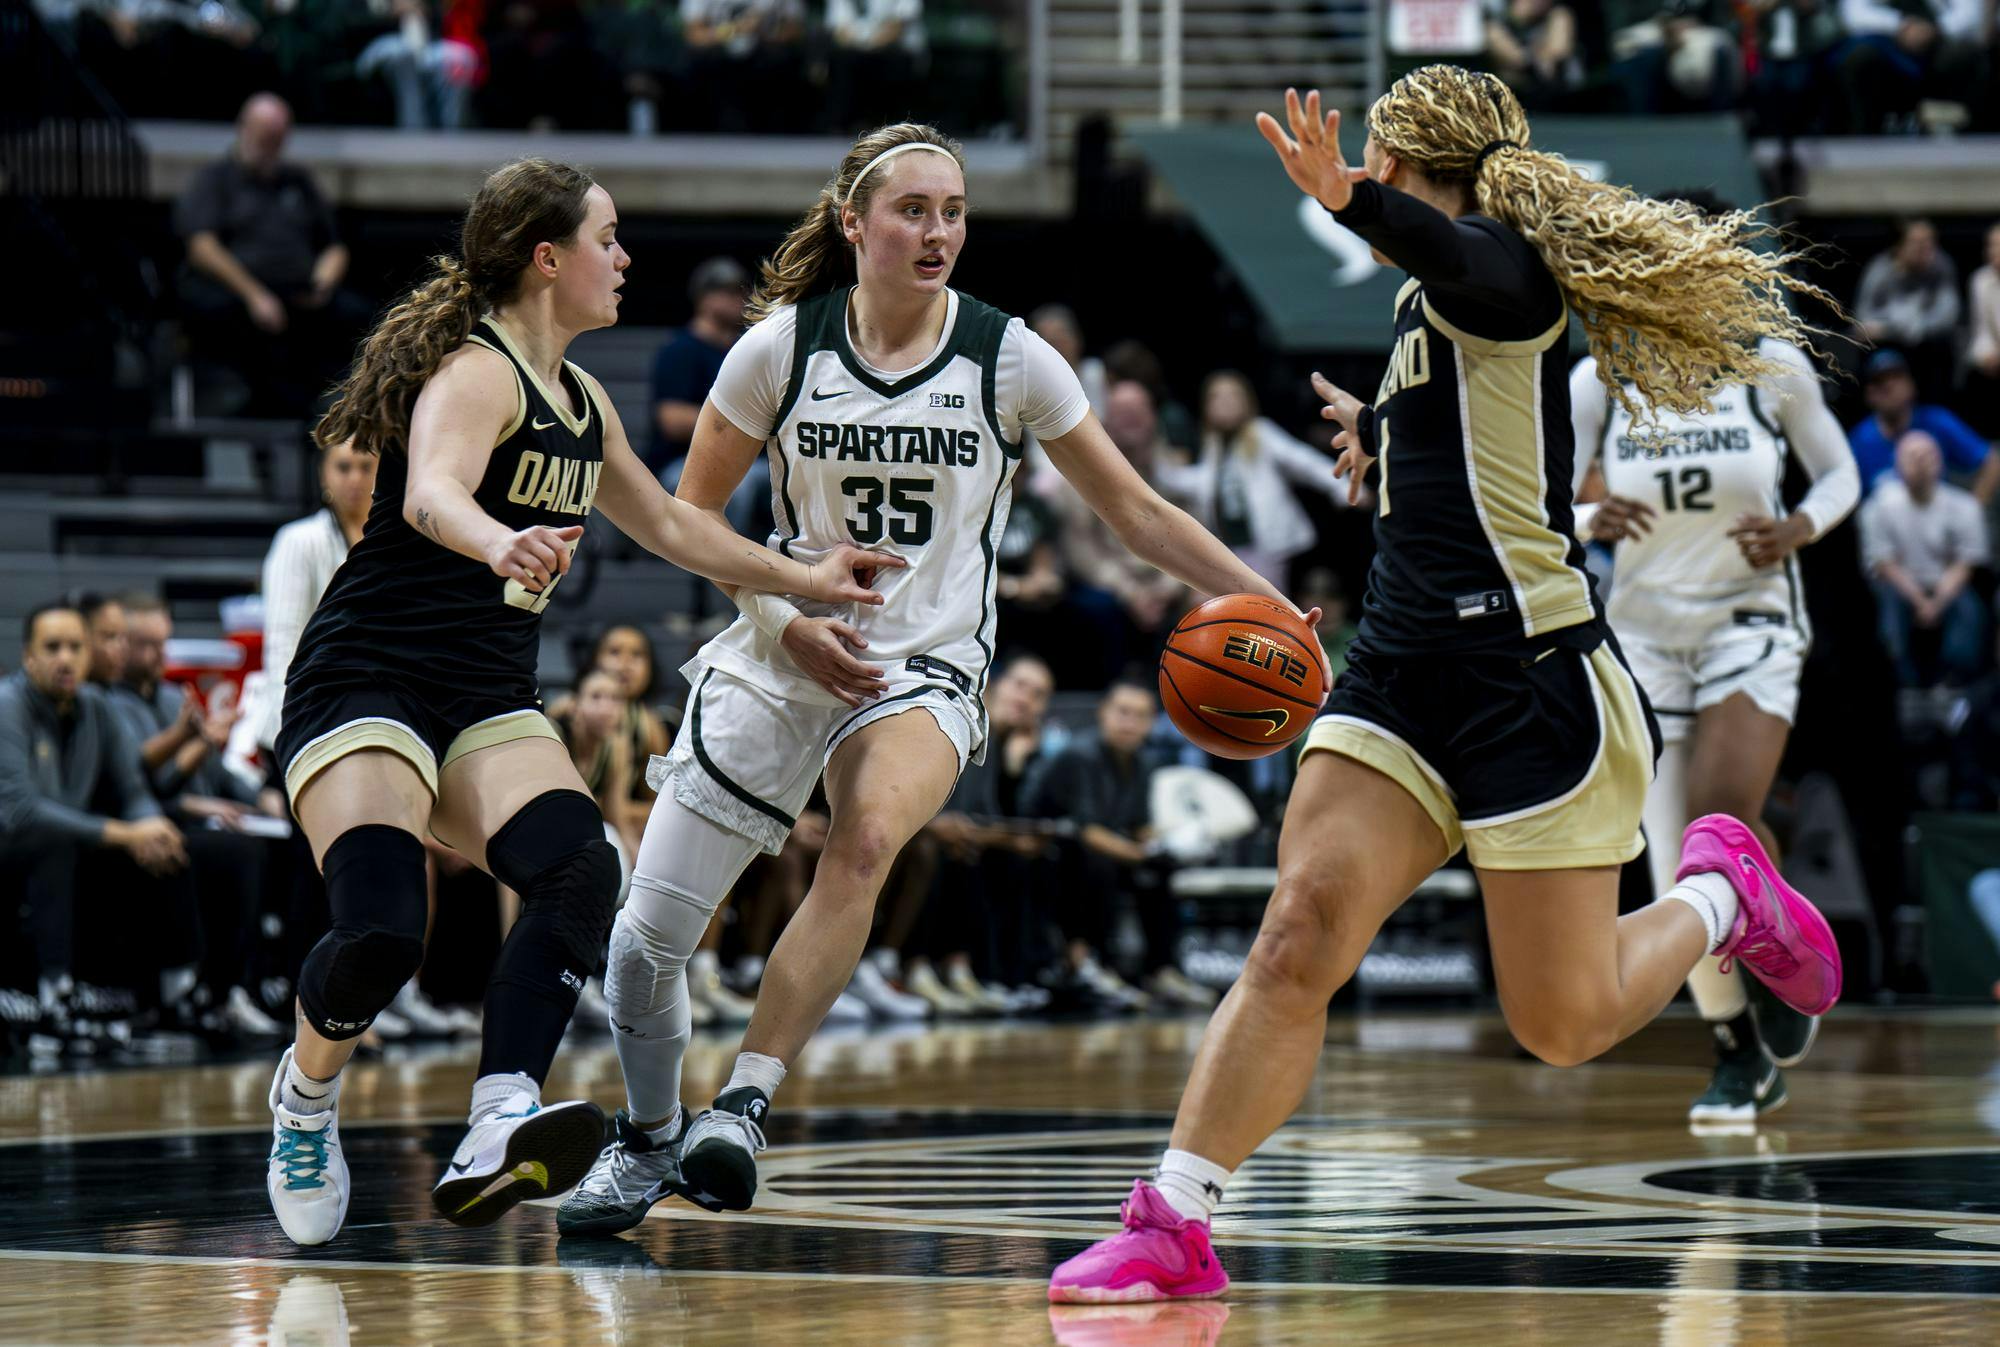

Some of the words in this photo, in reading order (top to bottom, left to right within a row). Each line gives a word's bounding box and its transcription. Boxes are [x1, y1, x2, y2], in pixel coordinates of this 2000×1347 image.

[796, 421, 980, 468] SPARTANS
[840, 476, 935, 547] 35
[1654, 464, 1715, 513] 12
[1222, 635, 1309, 688] ELITE
